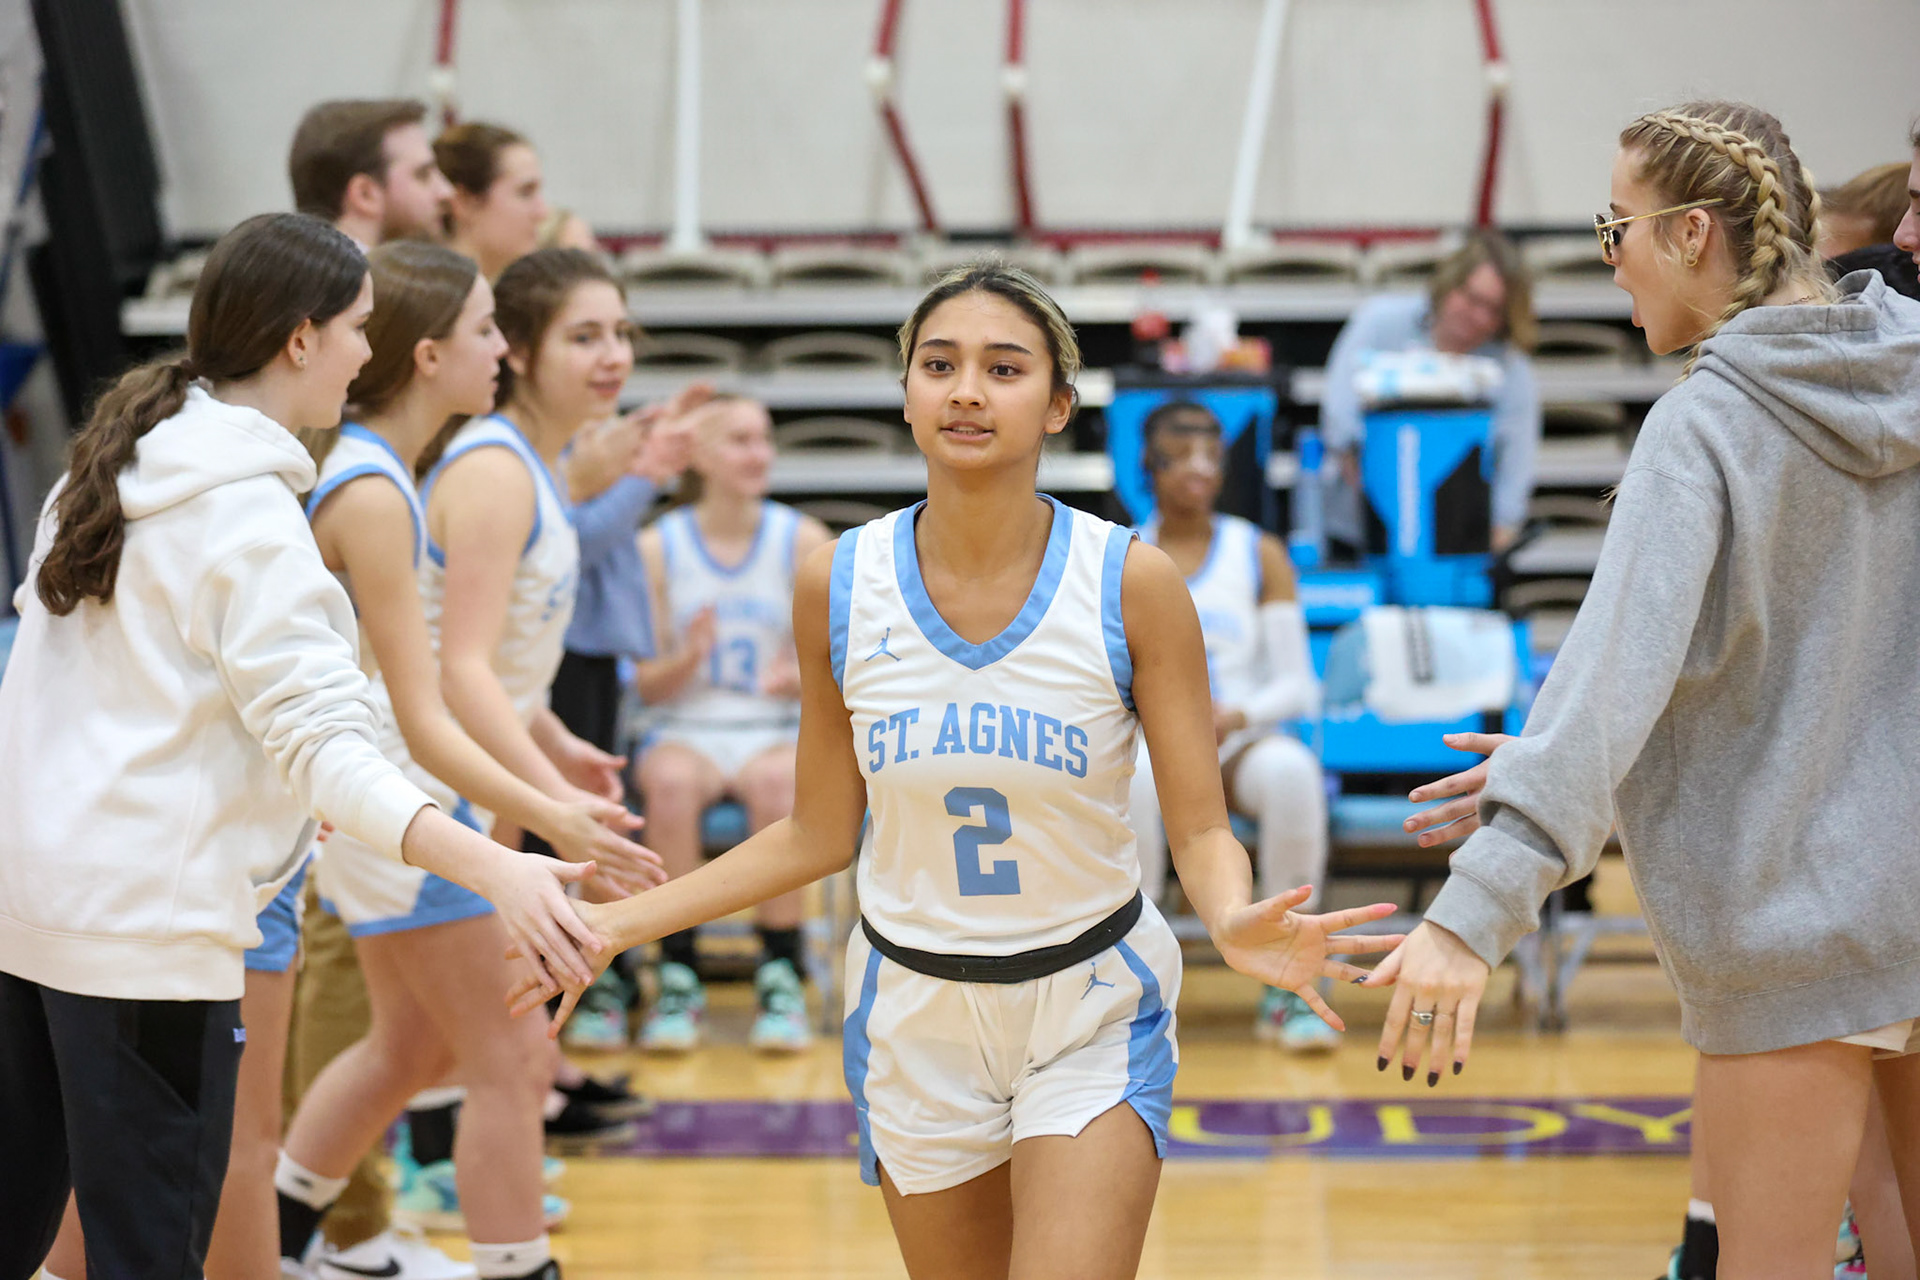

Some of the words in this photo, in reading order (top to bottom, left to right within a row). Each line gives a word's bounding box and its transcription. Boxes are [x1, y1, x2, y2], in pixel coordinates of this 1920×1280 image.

[868, 706, 920, 774] ST.
[932, 702, 1089, 779] AGNES
[943, 786, 1022, 896] 2
